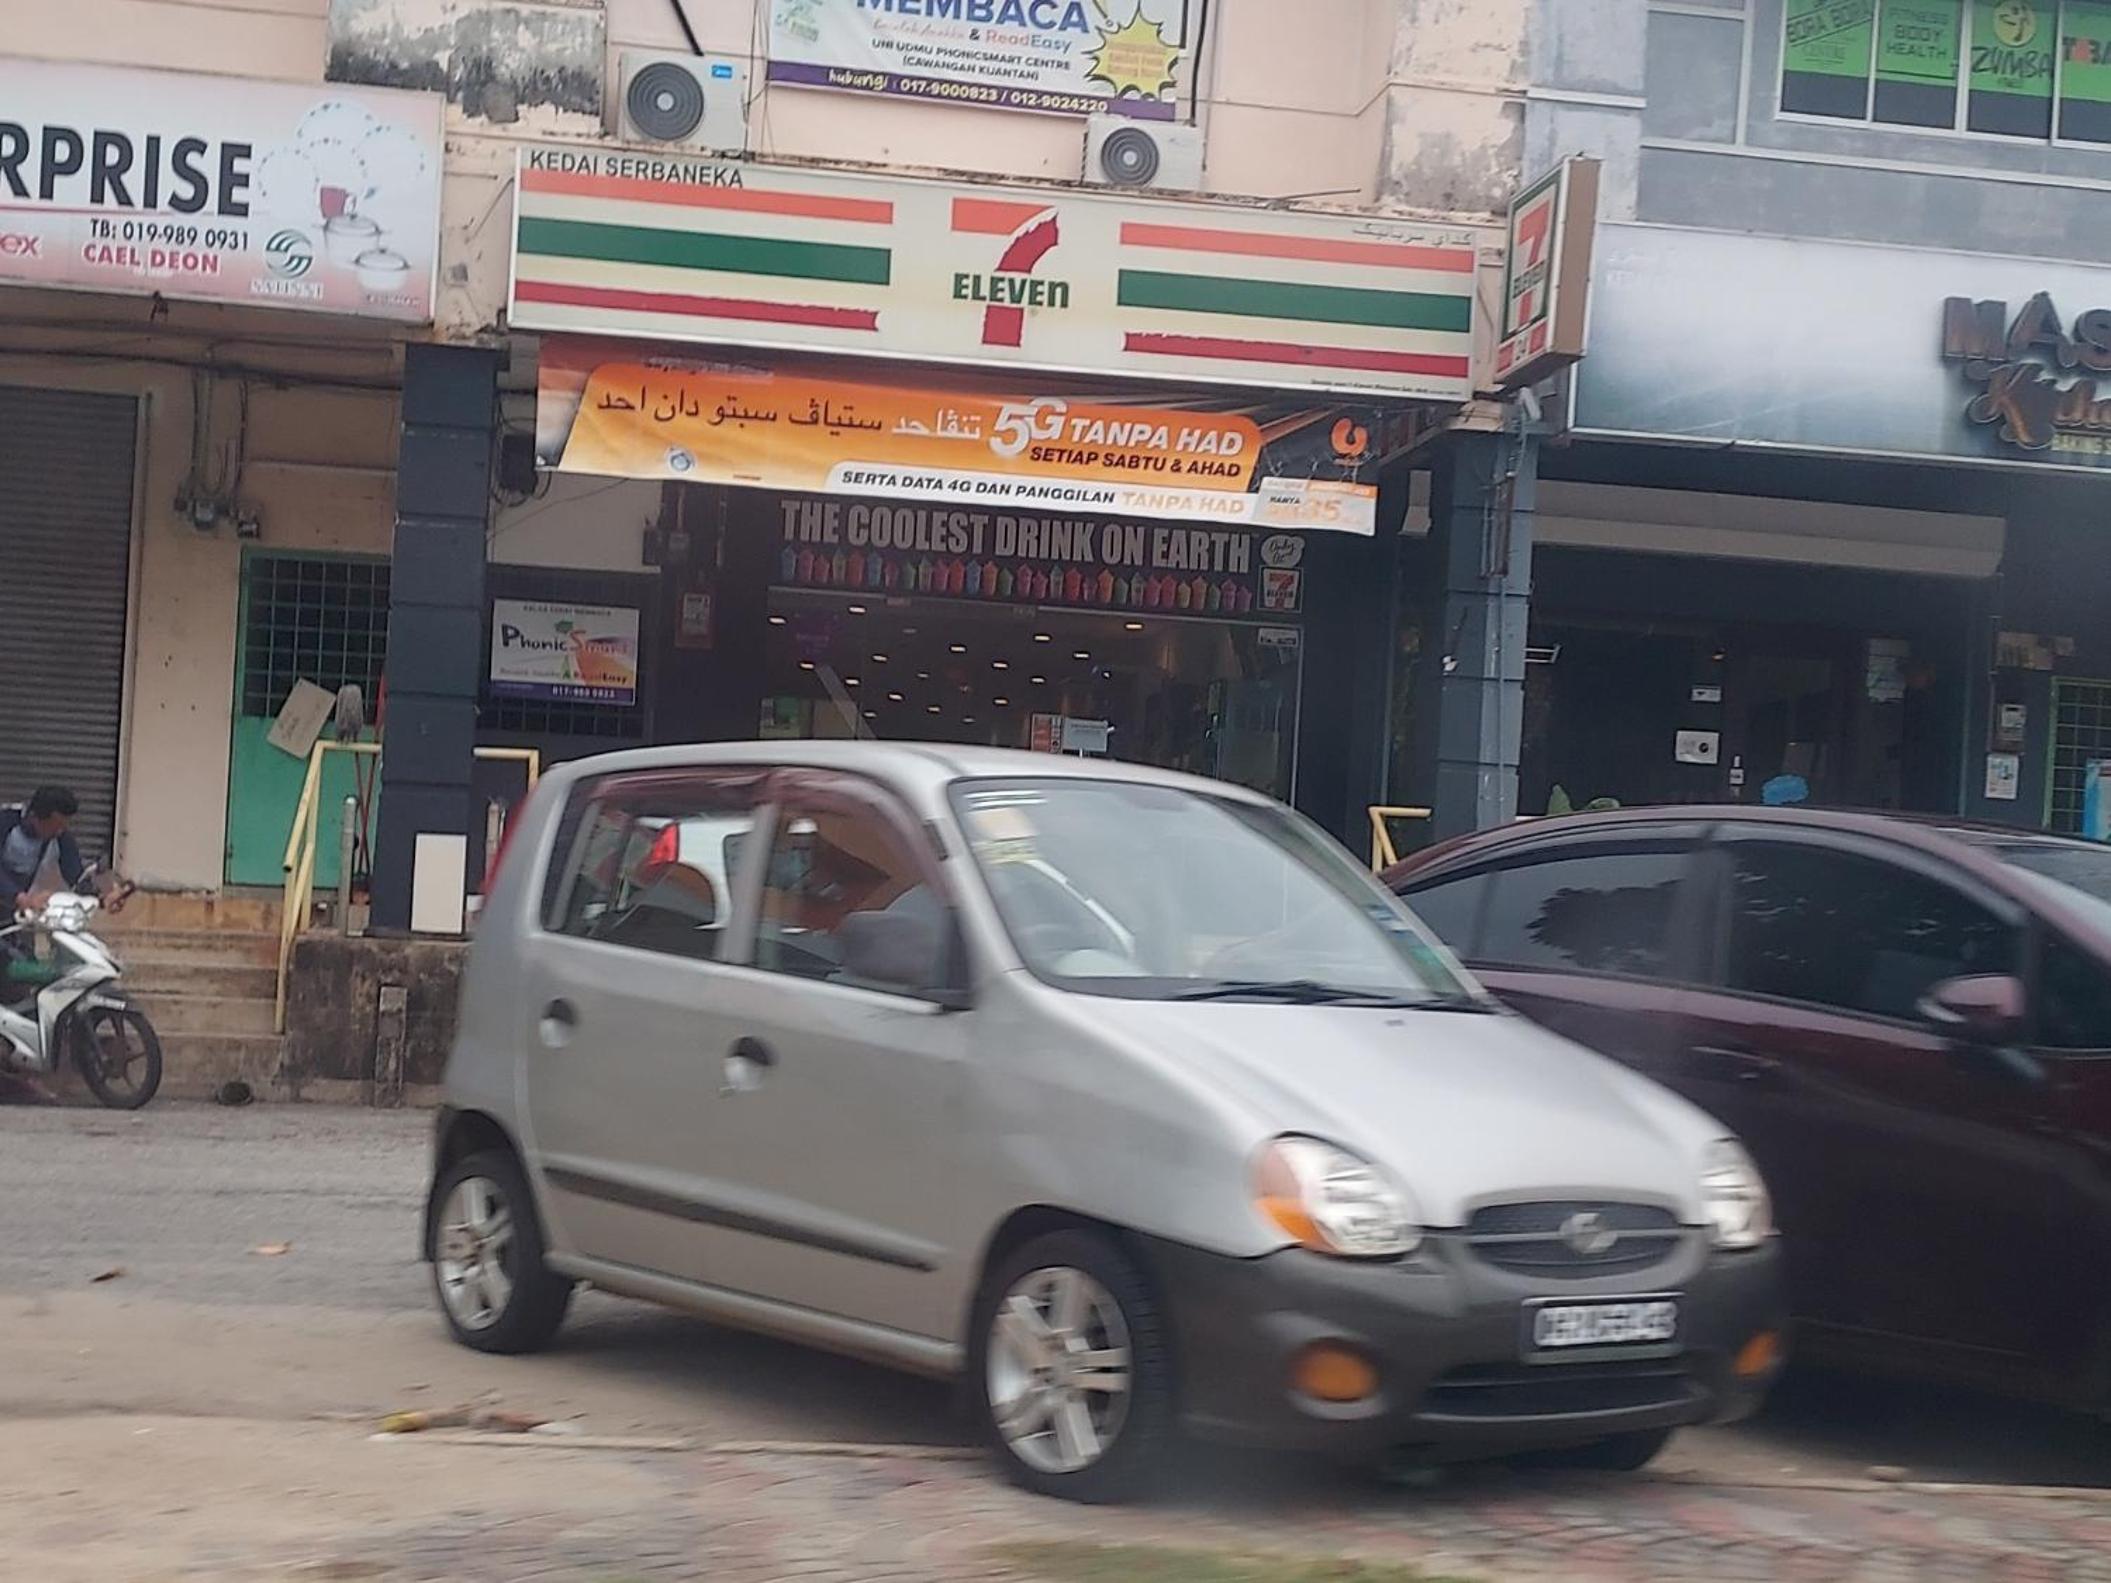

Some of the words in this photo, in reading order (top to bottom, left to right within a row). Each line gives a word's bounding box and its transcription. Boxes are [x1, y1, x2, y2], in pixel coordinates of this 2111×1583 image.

[857, 0, 1089, 33] MBACA
[969, 28, 980, 41] &
[985, 29, 1072, 53] ReadEasy
[1886, 43, 1948, 59] HEALTH
[1026, 56, 1071, 70] CENTRE
[1971, 46, 2051, 78] ZUMBA
[0, 121, 253, 218] RPRISE
[530, 150, 598, 175] KEDAI
[605, 157, 744, 189] SERBANEKA
[123, 220, 198, 245] 019-989
[205, 229, 248, 251] 0931
[84, 244, 141, 266] CAEL
[150, 250, 219, 273] DEON
[951, 197, 1059, 348] 7
[988, 396, 1068, 459] 5G
[1070, 417, 1169, 450] TANPA
[1176, 427, 1244, 456] HAD
[1029, 446, 1099, 465] SETIAP
[1102, 451, 1168, 472] SABTU
[1170, 458, 1182, 473] &
[1186, 460, 1241, 477] AHAD
[842, 470, 897, 487] SERTA
[901, 475, 943, 490] DATA
[948, 479, 972, 493] 4G
[975, 482, 1012, 496] DAN
[1015, 485, 1116, 504] PANGGILAN
[1122, 491, 1195, 510] TANPA
[1199, 496, 1245, 514] HAD
[780, 499, 842, 544] THE
[848, 504, 989, 555] COOLEST
[995, 516, 1095, 563] DRINK
[1101, 523, 1145, 566] ON
[1152, 527, 1251, 574] EARTH
